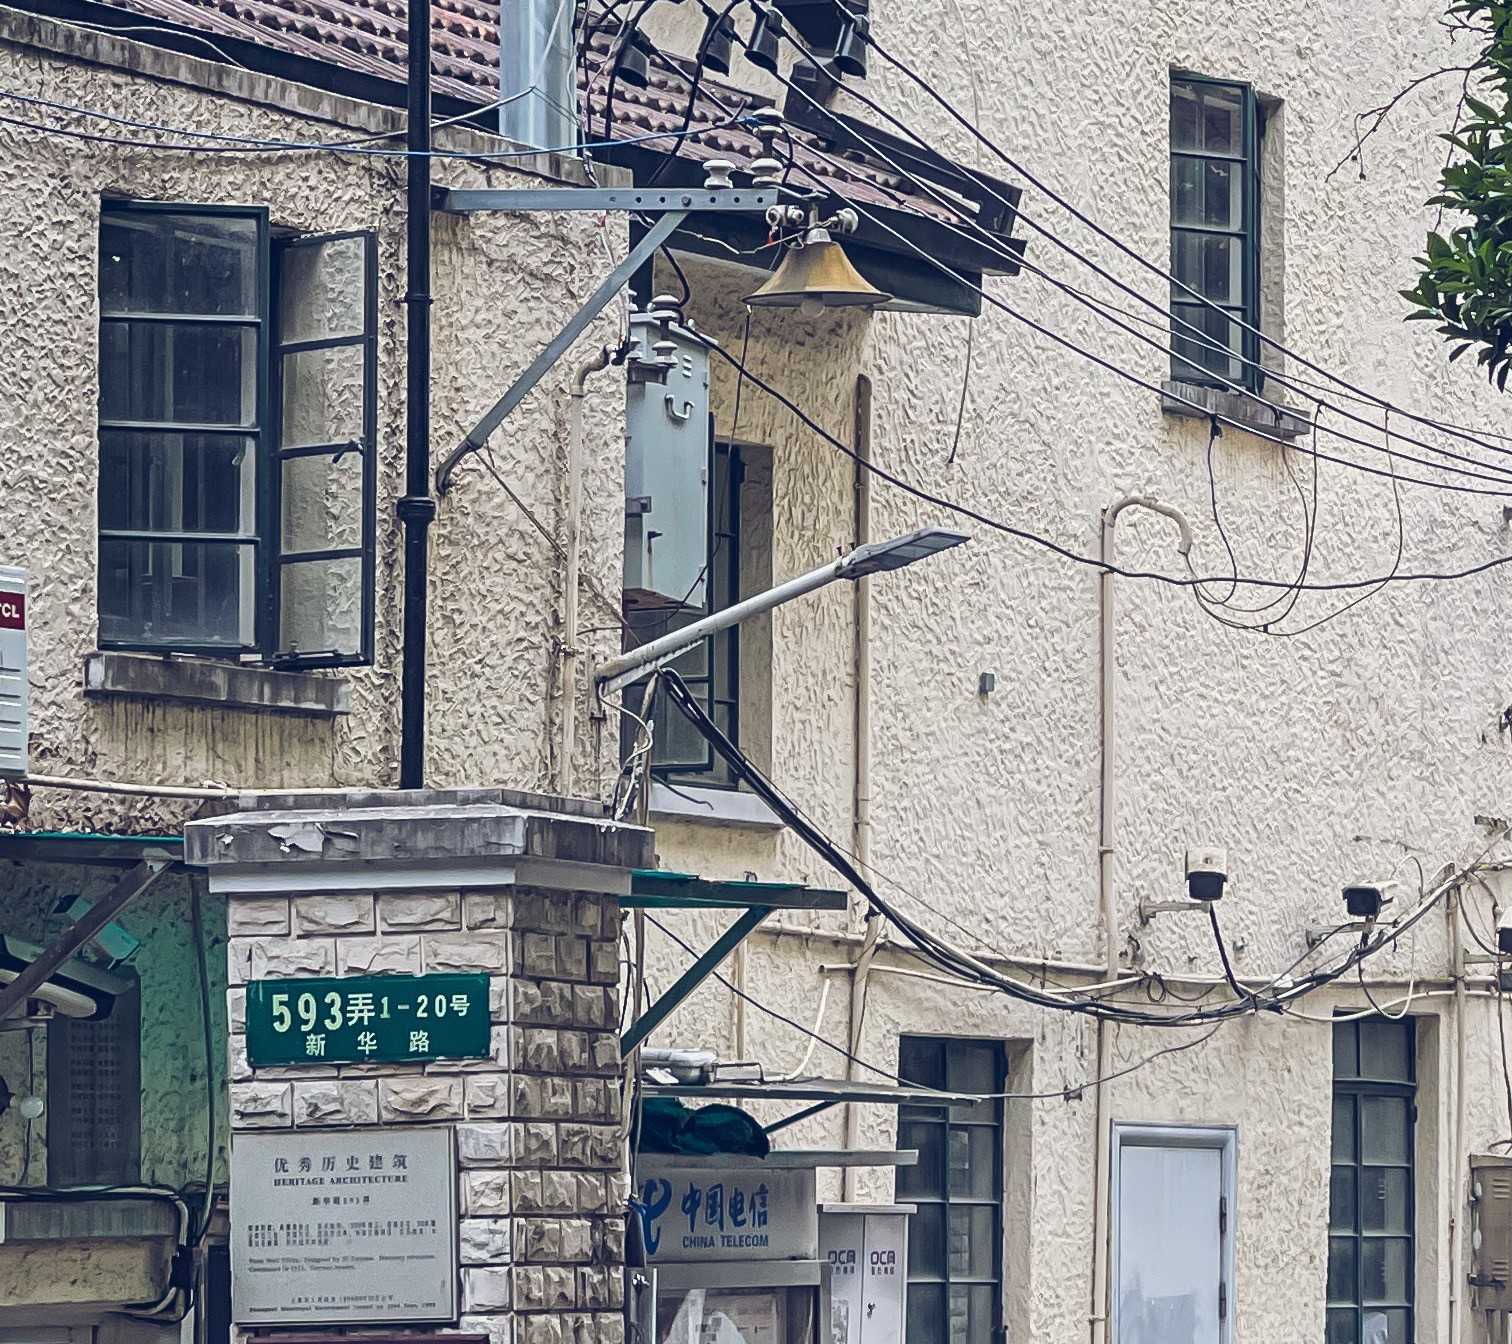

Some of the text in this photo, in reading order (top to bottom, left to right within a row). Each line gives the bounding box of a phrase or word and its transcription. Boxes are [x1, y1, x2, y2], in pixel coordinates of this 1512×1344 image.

[0, 603, 20, 618] CL
[271, 991, 470, 1033] 593弄1-20号
[305, 1030, 430, 1057] 新华路
[273, 1154, 409, 1173] 优秀历史建筑
[273, 1174, 408, 1187] HERITAGE ARCHITECTURE
[681, 1181, 769, 1233] 中国电信
[682, 1233, 769, 1249] CHINA TELECOM
